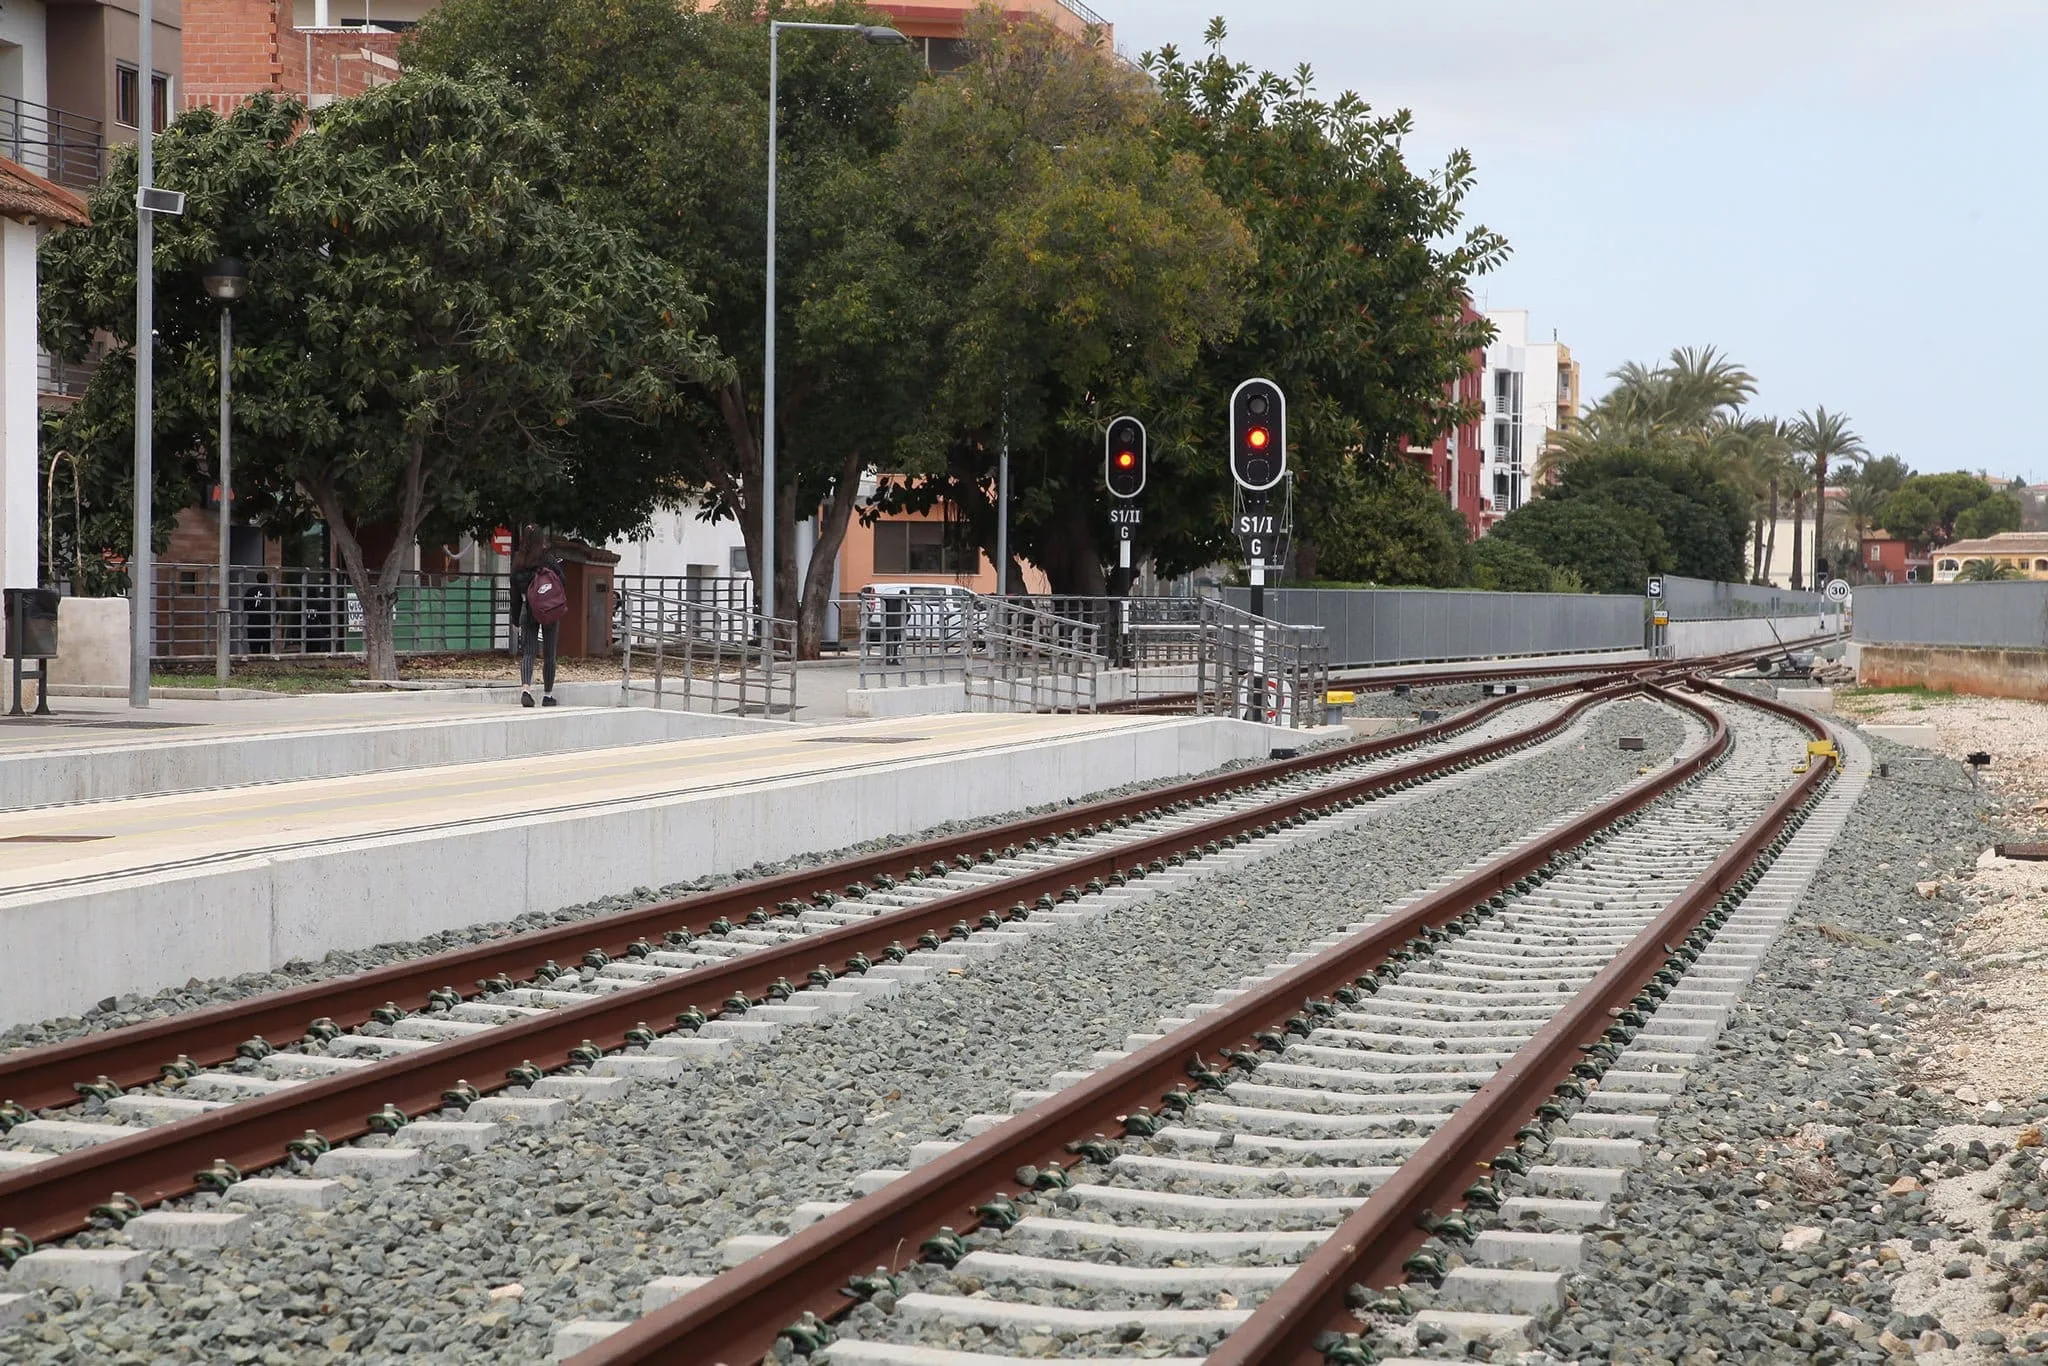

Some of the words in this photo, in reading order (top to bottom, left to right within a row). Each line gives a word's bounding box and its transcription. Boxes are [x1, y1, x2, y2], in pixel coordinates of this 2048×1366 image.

[1110, 510, 1141, 523] S1/II
[1240, 516, 1273, 533] S1/I
[1120, 526, 1129, 538] G
[1251, 538, 1262, 555] G
[1650, 581, 1660, 594] S
[1831, 586, 1845, 595] 30
